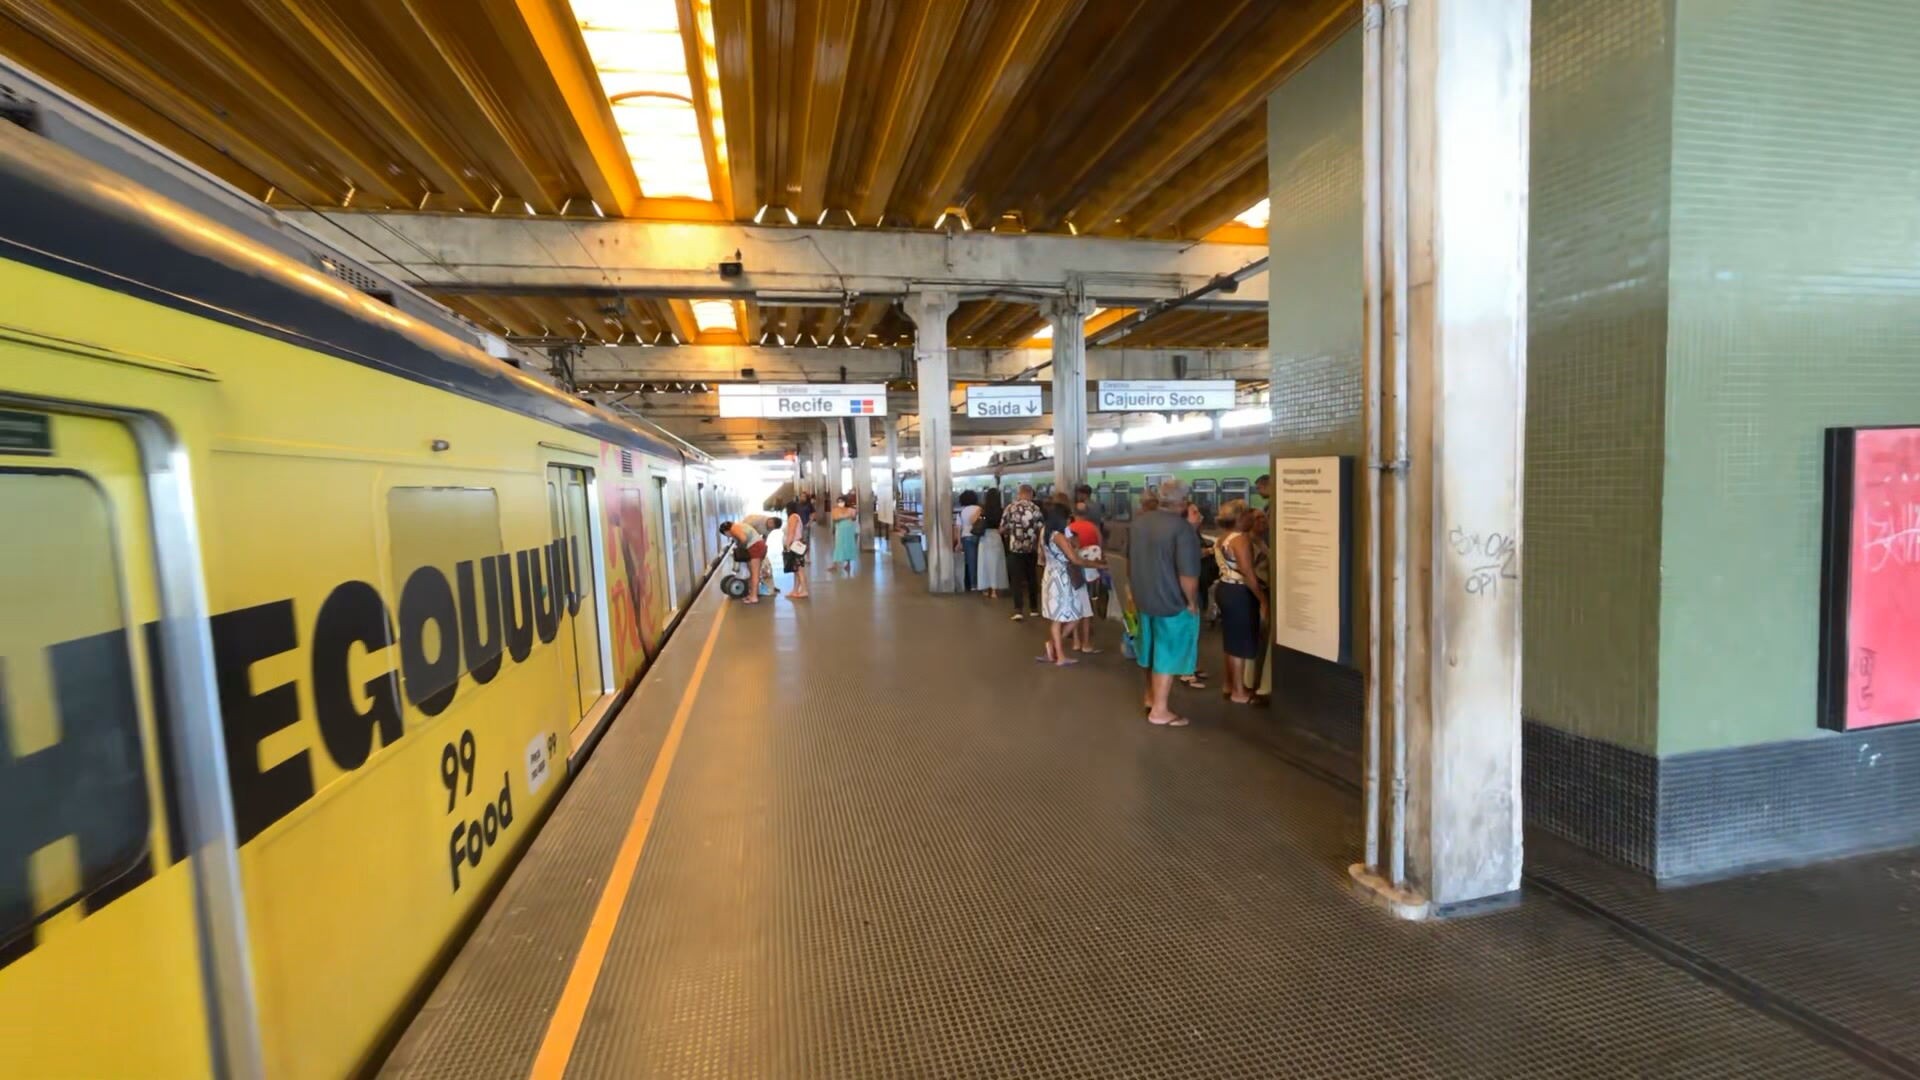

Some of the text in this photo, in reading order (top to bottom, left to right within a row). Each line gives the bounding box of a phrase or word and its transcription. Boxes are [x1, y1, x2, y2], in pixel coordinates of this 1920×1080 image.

[778, 397, 833, 412] Recife
[1104, 392, 1205, 408] Cajueiro Seco
[441, 728, 476, 814] 99
[449, 770, 514, 895] Food
